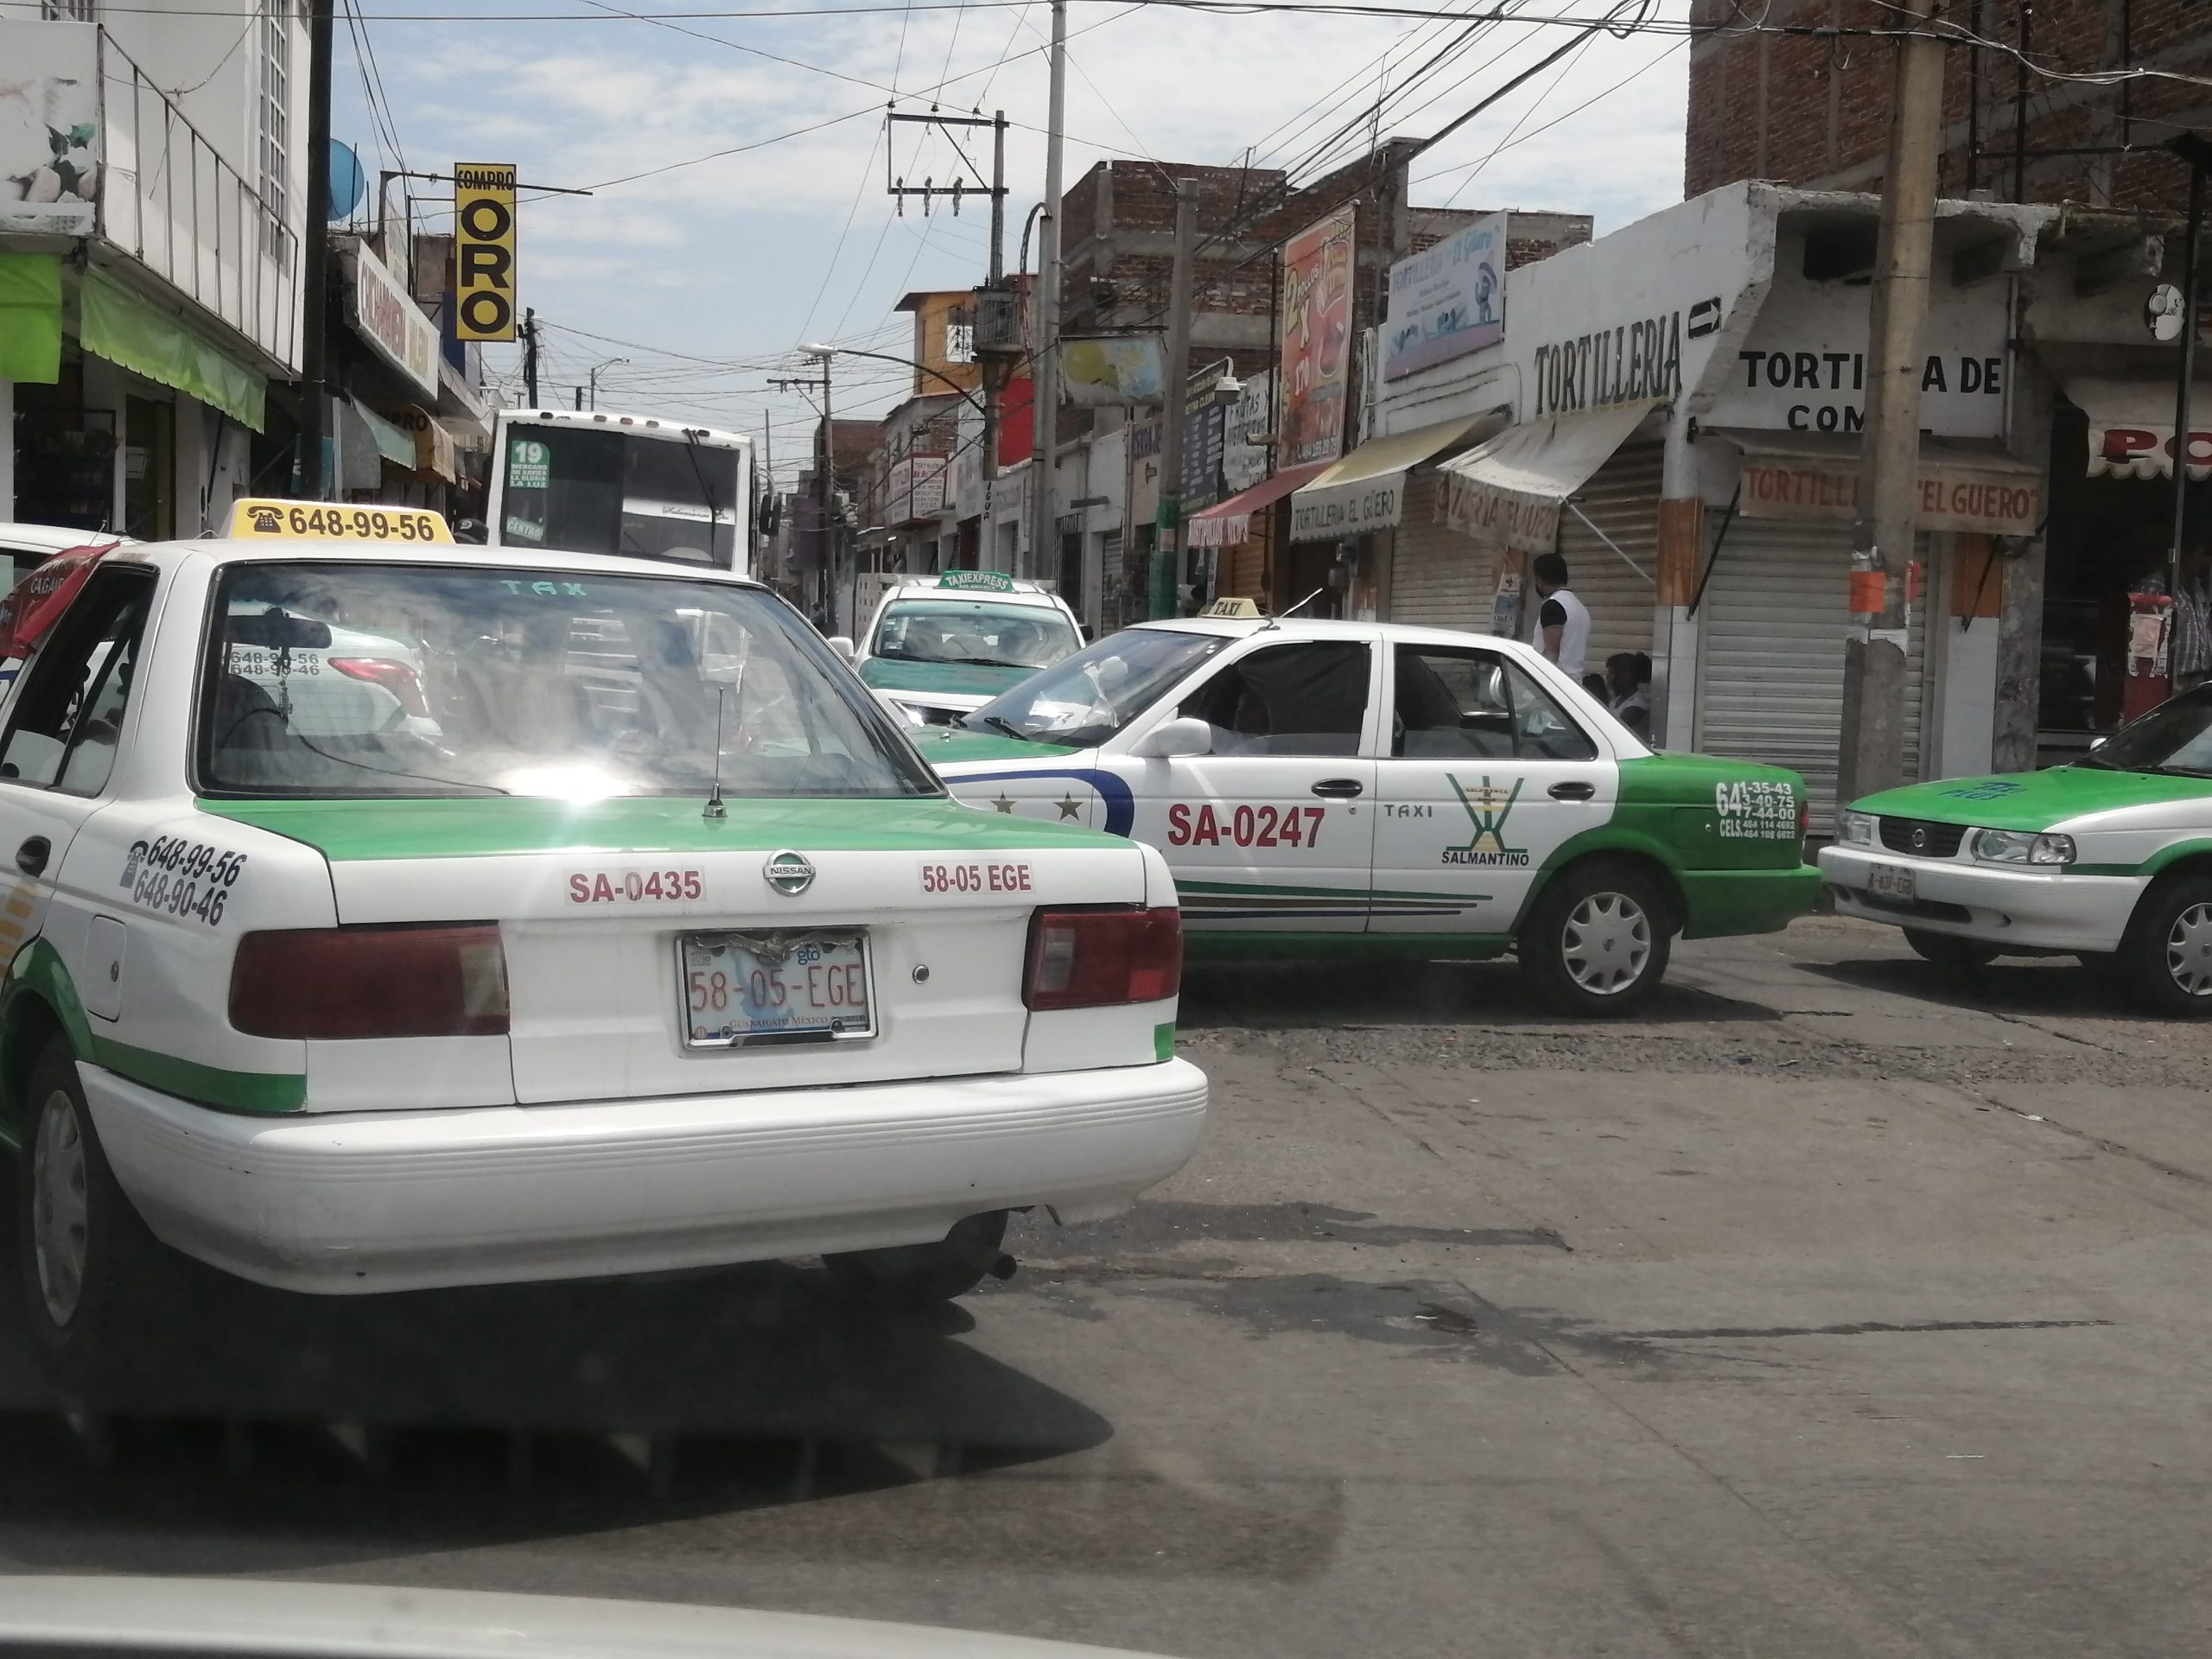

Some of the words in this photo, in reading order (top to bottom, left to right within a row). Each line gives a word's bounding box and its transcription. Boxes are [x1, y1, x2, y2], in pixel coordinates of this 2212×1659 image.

[457, 170, 515, 191] COMPRO
[461, 199, 512, 334] ORO
[1535, 311, 1682, 415] TORTILLERIA
[1739, 351, 1948, 392] TORTIA
[1961, 357, 2001, 394] DE
[515, 442, 543, 464] 19
[289, 507, 435, 542] 648-99-56
[506, 519, 543, 538] CENTRO
[945, 573, 1008, 590] TAXIEXPRESS
[1214, 601, 1242, 616] TAXI
[1384, 804, 1433, 818] TAXI
[1168, 804, 1325, 848] SA-0247
[148, 836, 248, 887] 648-99-56
[770, 866, 812, 875] NISSAN
[1441, 851, 1529, 867] SALMANTINO
[569, 871, 702, 903] SA-0435
[923, 865, 982, 893] 58-05
[988, 864, 1031, 891] EGE
[133, 869, 228, 926] 648-90-46
[797, 945, 820, 965] gto
[690, 964, 864, 1011] 58-05-EGE
